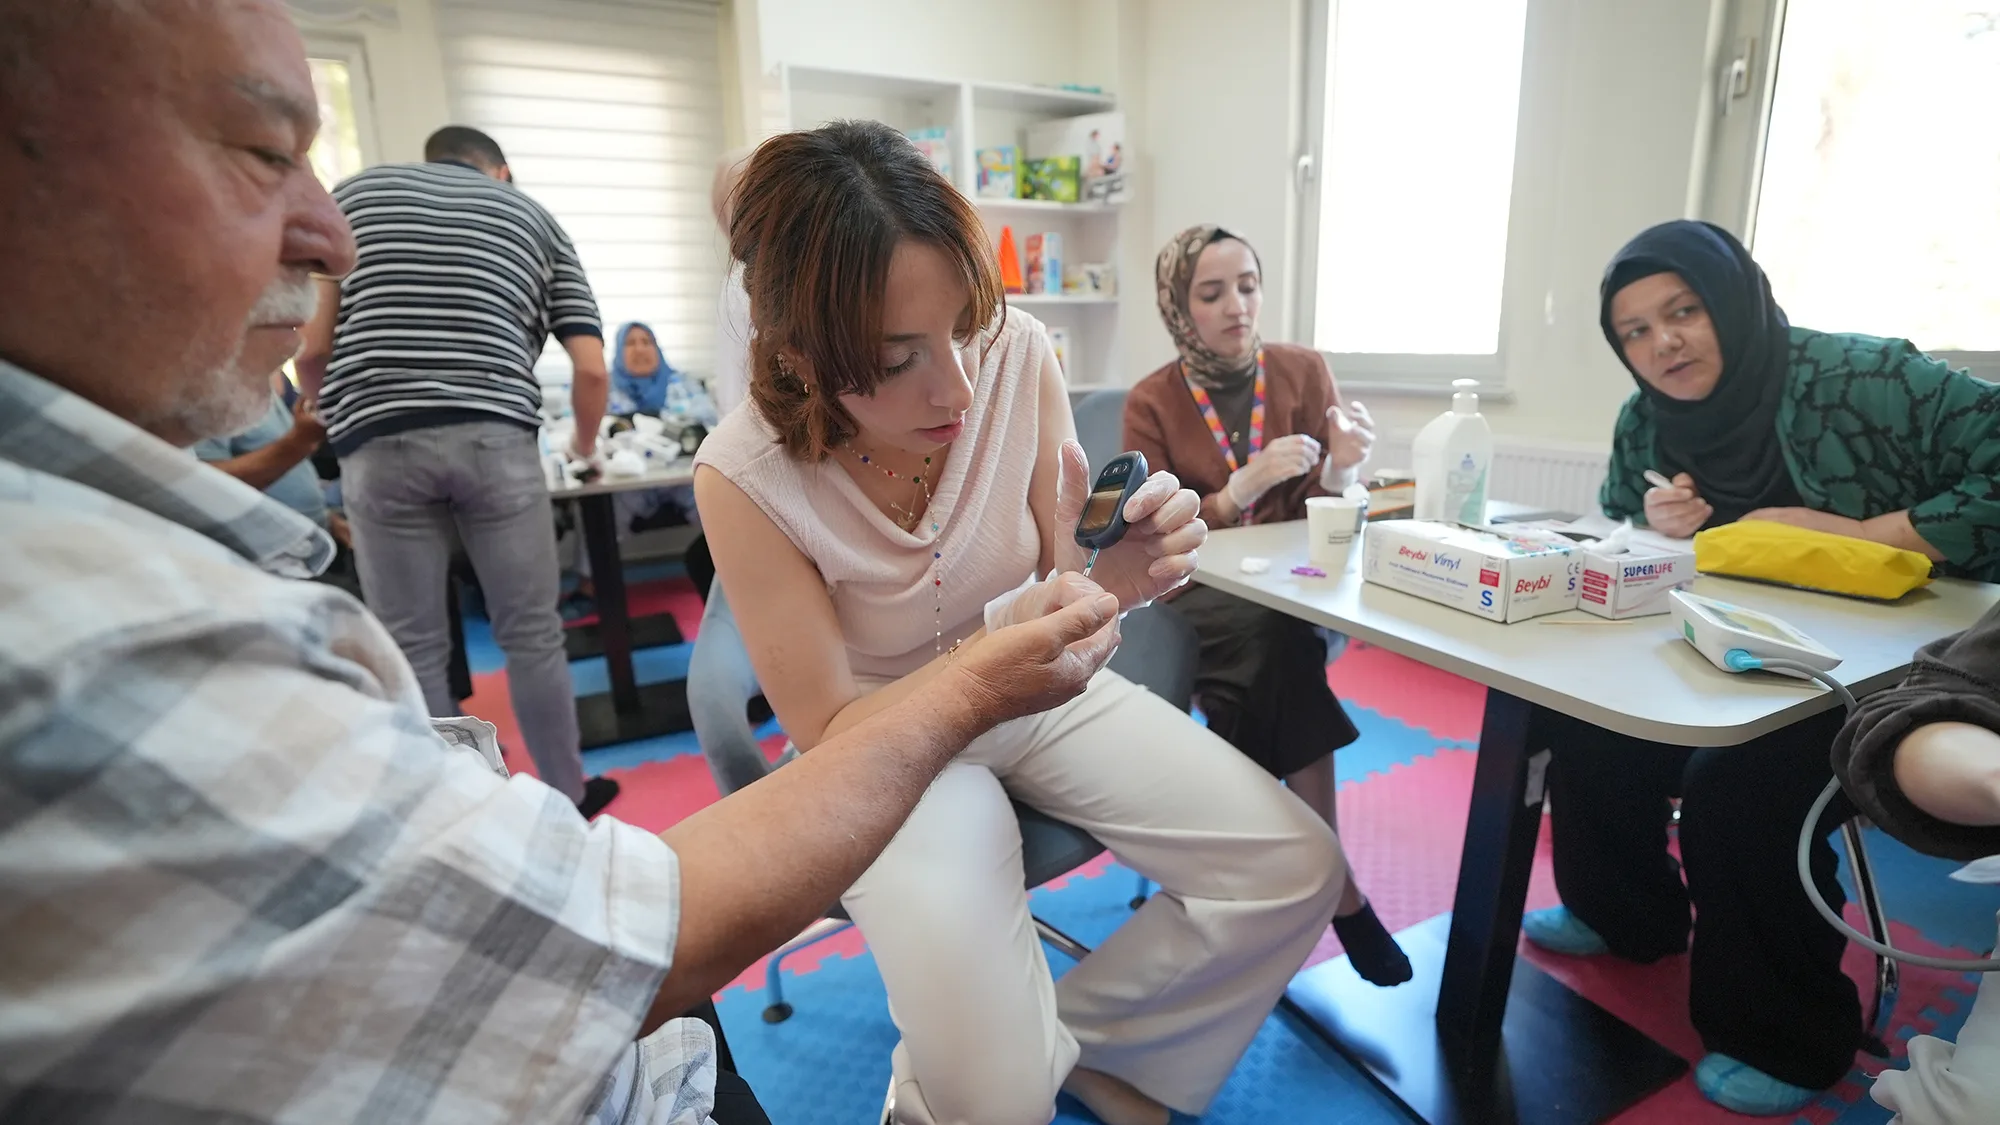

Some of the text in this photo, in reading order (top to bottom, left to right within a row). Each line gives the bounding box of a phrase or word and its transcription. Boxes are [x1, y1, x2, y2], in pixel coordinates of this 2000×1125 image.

[1399, 546, 1461, 570] Beybi Vinyl
[1624, 563, 1672, 577] SUPERLIFE
[1515, 575, 1551, 593] Beybi
[1568, 577, 1576, 590] S
[1481, 590, 1493, 606] S
